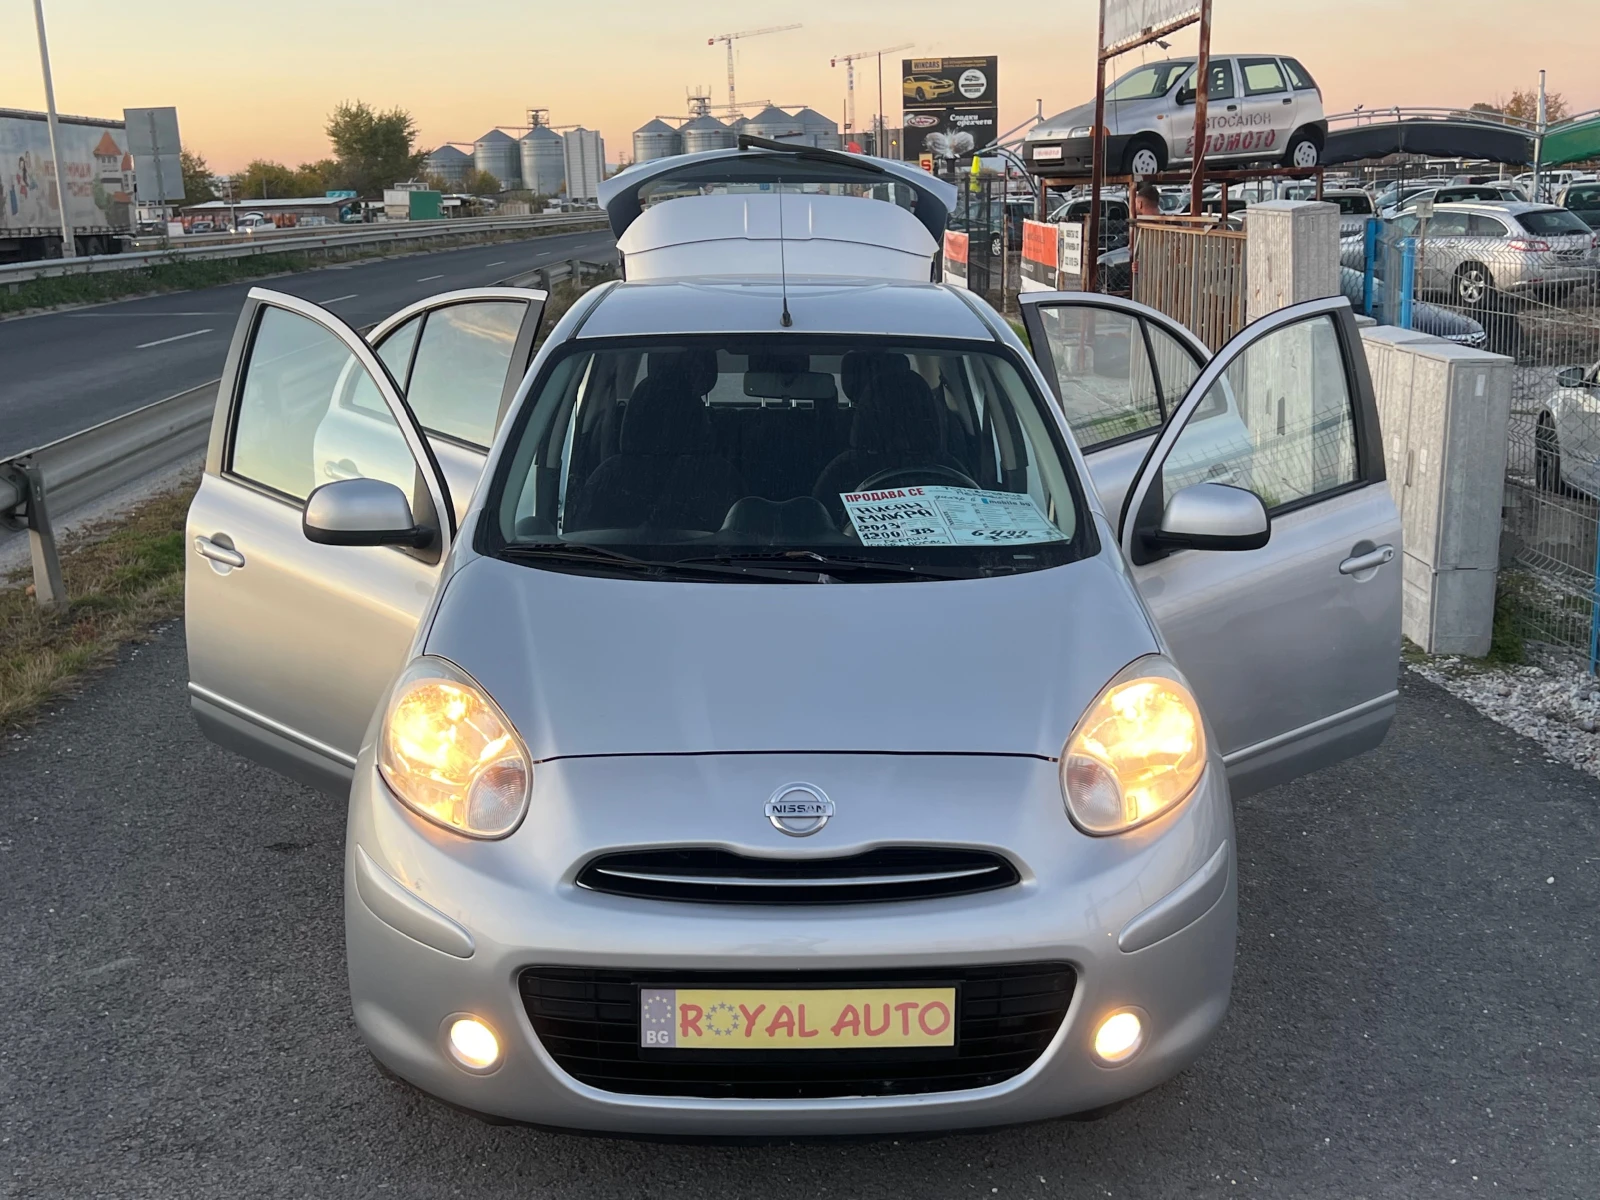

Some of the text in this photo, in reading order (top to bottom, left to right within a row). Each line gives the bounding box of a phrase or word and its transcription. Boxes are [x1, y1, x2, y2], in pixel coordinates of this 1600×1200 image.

[914, 61, 940, 69] WINCARS
[1191, 112, 1272, 130] ВТОСАЛОН
[844, 487, 926, 503] ПРОДАВА СЕ
[855, 502, 924, 515] НИСАН
[856, 508, 934, 524] МИКРА
[858, 522, 901, 532] 2013
[862, 530, 901, 540] 1200
[772, 804, 827, 813] NISSAN
[831, 1001, 950, 1038] AUTO
[645, 1030, 669, 1044] BG
